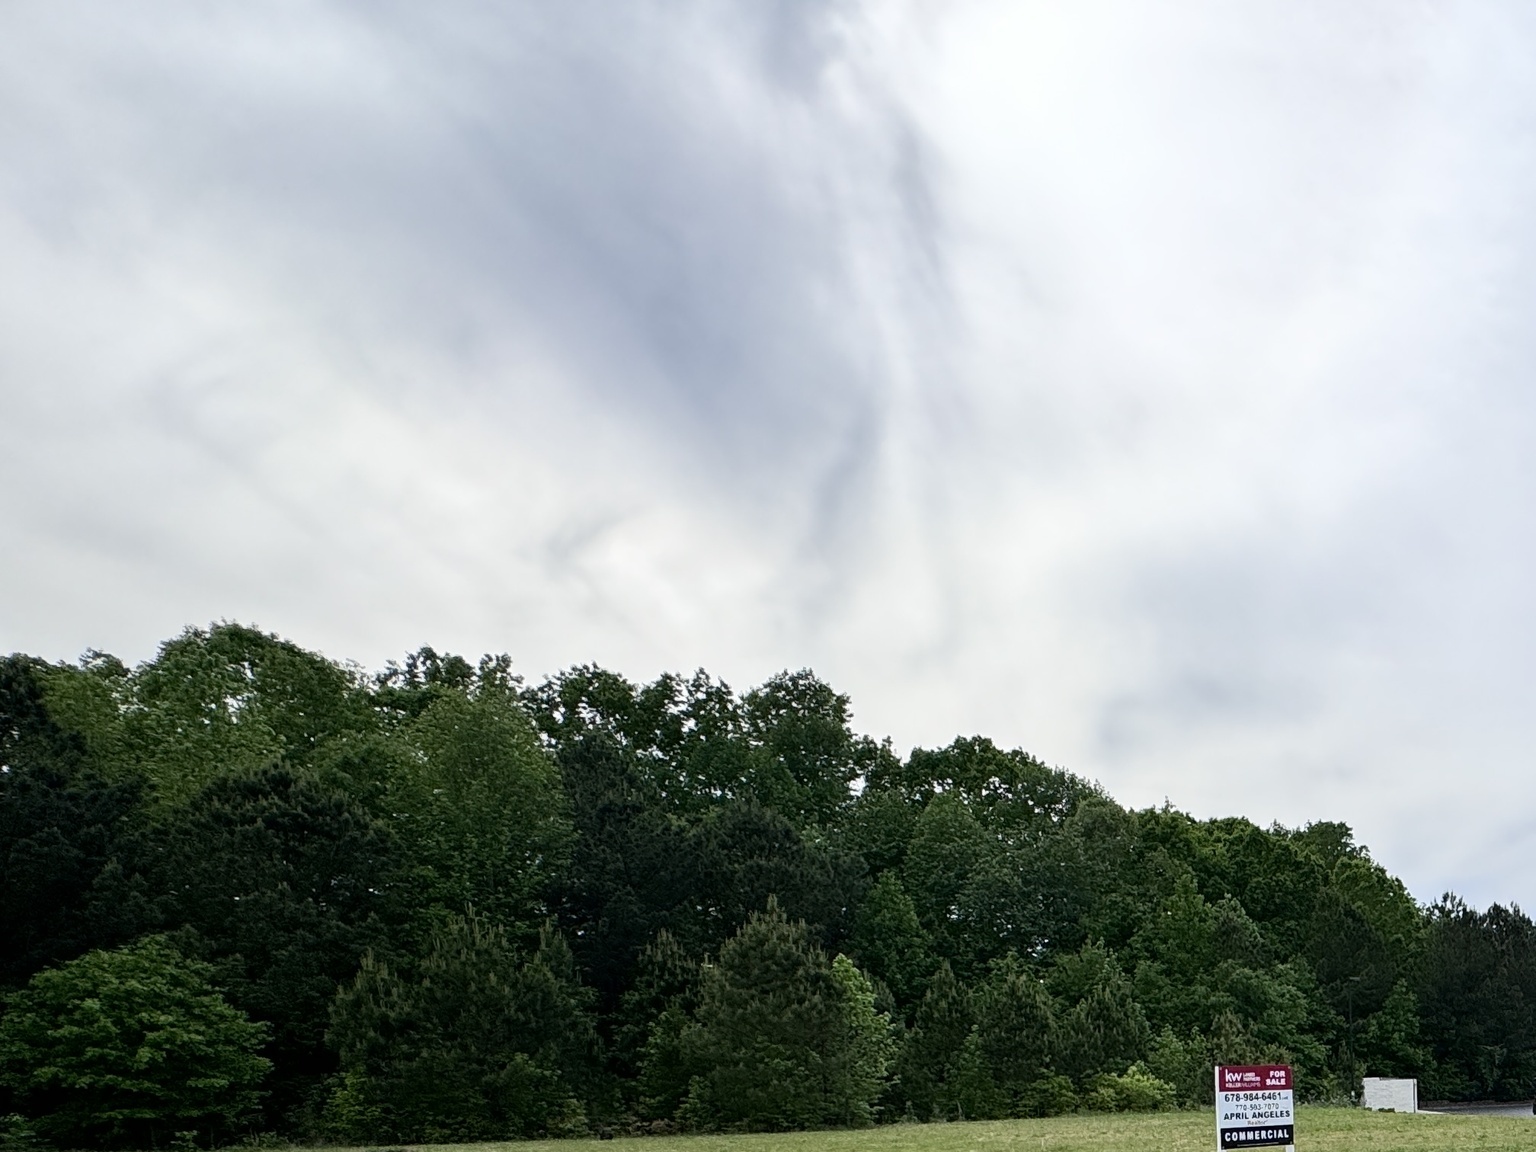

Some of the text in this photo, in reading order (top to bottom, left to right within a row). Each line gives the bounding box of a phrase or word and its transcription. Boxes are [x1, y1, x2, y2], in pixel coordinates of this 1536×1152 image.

[1269, 1070, 1286, 1078] FOR
[1265, 1078, 1286, 1086] SALE
[1224, 1092, 1282, 1102] 678-984-6461
[1223, 1110, 1290, 1120] APRIL ANGELES
[1224, 1129, 1290, 1142] COMMERCIAL
